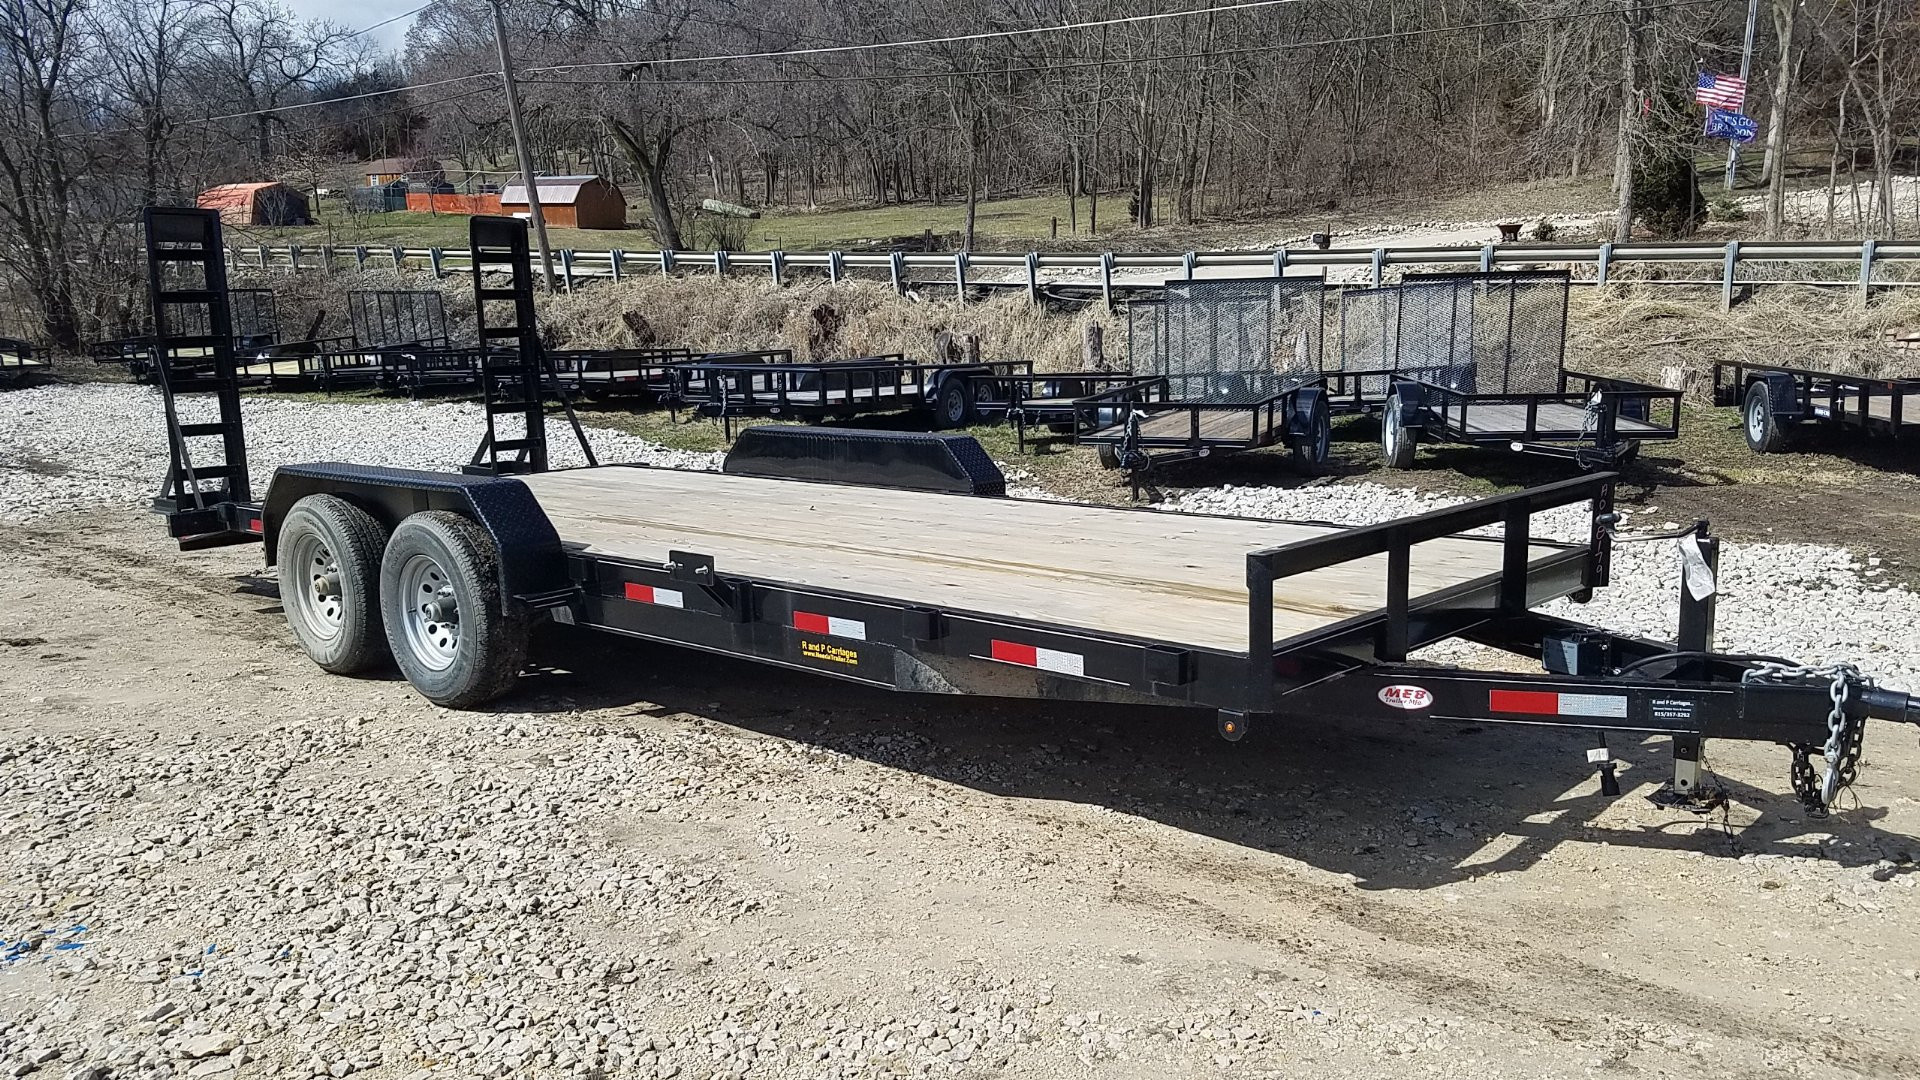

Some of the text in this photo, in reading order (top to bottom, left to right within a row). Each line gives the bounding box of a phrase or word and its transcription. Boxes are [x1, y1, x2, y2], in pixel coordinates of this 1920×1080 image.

[1738, 117, 1753, 127] GO
[802, 640, 808, 650] R
[808, 643, 820, 652] and
[820, 644, 826, 653] P
